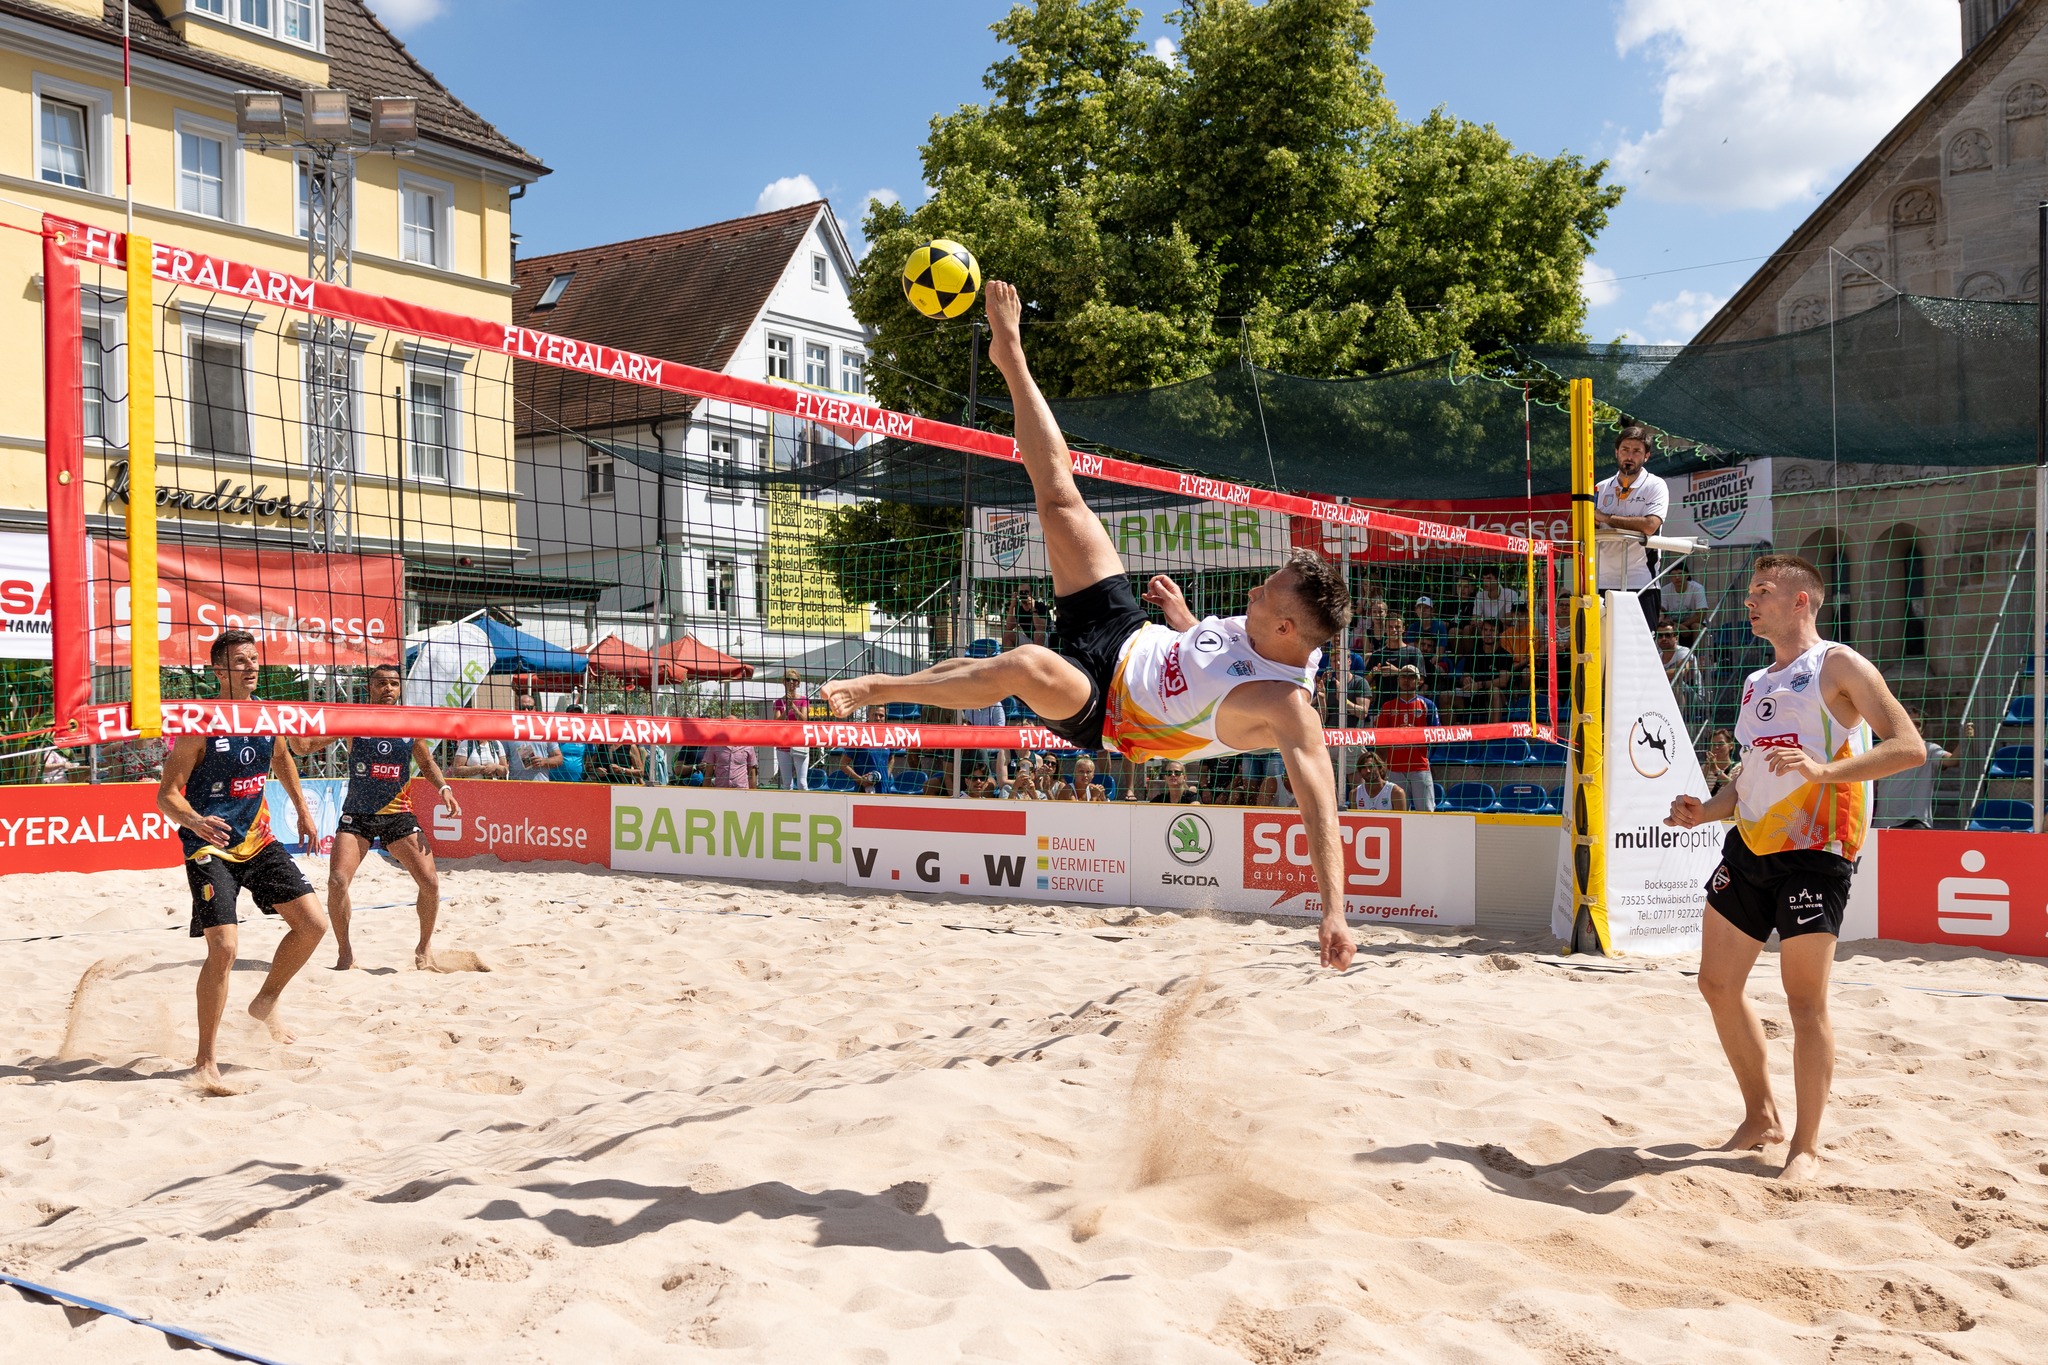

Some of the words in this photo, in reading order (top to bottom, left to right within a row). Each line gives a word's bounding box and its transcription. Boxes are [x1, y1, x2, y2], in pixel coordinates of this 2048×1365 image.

[86, 227, 315, 310] FLERALARM
[503, 326, 663, 384] FLYERALARM
[796, 392, 913, 438] FLYERALARM
[1699, 473, 1738, 489] EUROPEAN
[1179, 475, 1250, 504] FLYERALARM
[1683, 476, 1755, 508] FOOTVOLLEY
[1311, 501, 1369, 526] FLYERALARM
[1694, 493, 1748, 522] LEAGUE
[1418, 521, 1467, 542] FLYERALARM
[771, 586, 792, 597] über
[794, 587, 800, 597] 2
[1761, 702, 1772, 717] 2
[97, 704, 326, 740] FLERALARM
[1642, 711, 1671, 726] FOOTVOLLEY
[512, 714, 671, 744] FLYERALARM
[803, 724, 921, 747] FLYERALARM
[1423, 728, 1473, 743] FLYERALARM
[1321, 730, 1376, 745] LYERALARM
[381, 743, 388, 752] 2
[373, 765, 400, 777] sorg
[0, 813, 181, 847] YERALARM
[474, 816, 588, 849] Sparkasse
[615, 806, 842, 863] BARMER
[1052, 837, 1095, 851] BAUEN
[1615, 826, 1720, 852] mülleroptik
[1051, 857, 1125, 873] VERMIETEN
[1051, 877, 1104, 892] SERVICE
[1161, 872, 1220, 887] ŠKODA
[1644, 880, 1688, 891] Bocksgasse
[1690, 879, 1698, 888] 28
[1621, 896, 1645, 905] 73525
[1647, 894, 1691, 904] Schwäbisch
[1359, 904, 1438, 919] sorgenfrei.
[1638, 911, 1652, 920] Tel.:
[1653, 910, 1675, 919] 07171
